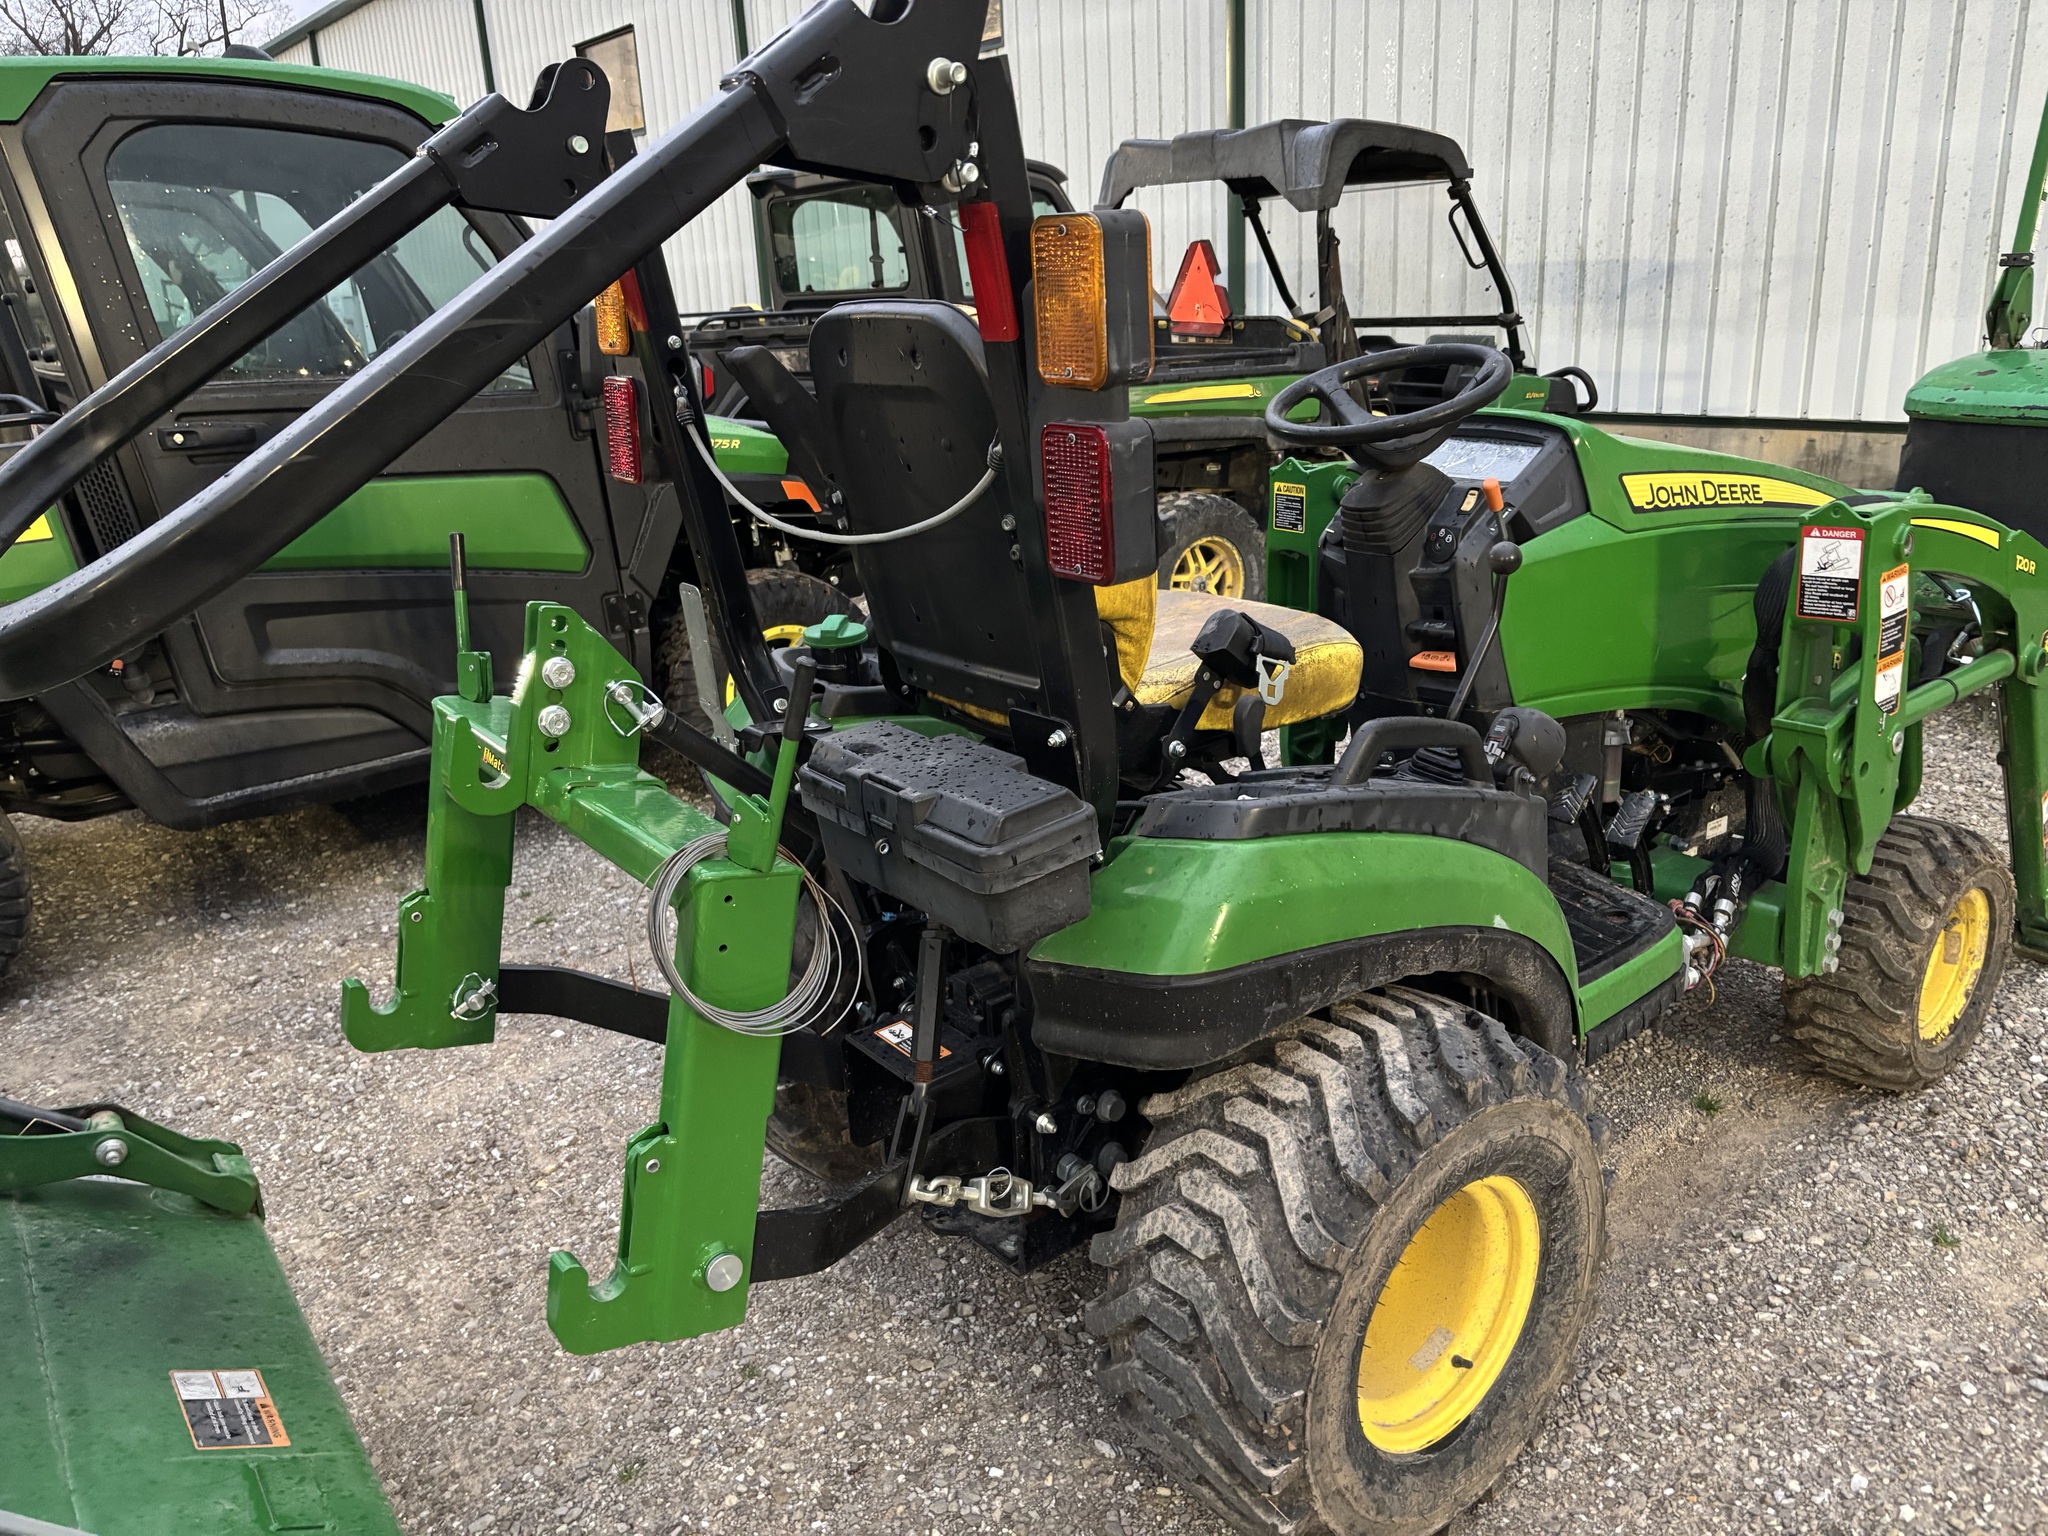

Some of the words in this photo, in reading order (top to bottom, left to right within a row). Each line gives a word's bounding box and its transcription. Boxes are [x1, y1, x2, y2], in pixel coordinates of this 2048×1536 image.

[1283, 485, 1305, 495] CAUTION
[1645, 483, 1699, 505] JOHN
[1701, 480, 1763, 501] DEERE
[1822, 529, 1857, 539] DANGER
[1886, 565, 1908, 582] WARNING
[1882, 654, 1903, 671] WARNING
[263, 1408, 282, 1438] WARNING
